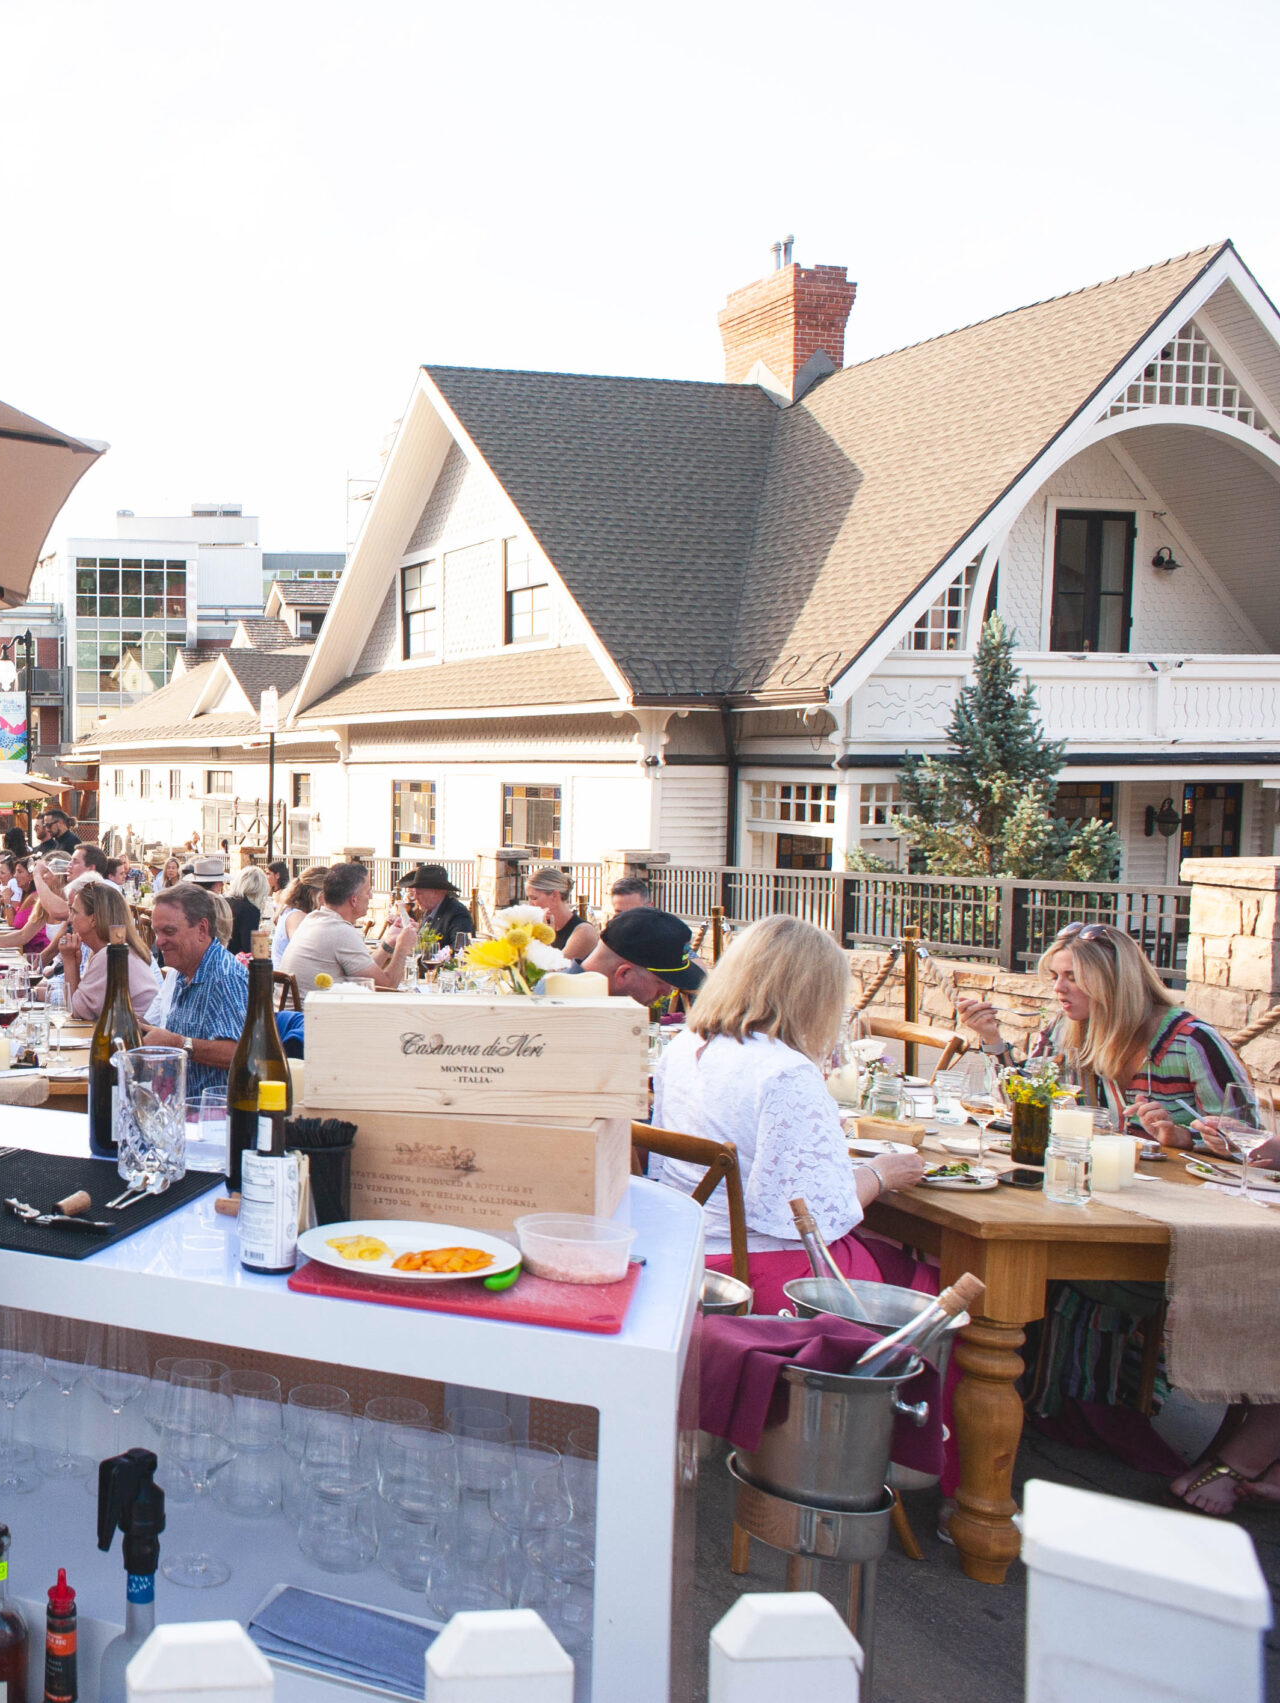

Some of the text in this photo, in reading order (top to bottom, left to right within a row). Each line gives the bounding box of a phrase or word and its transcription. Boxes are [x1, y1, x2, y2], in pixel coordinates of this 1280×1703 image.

[400, 1032, 547, 1058] Casanova di Neri
[440, 1065, 505, 1074] MONTALCINO
[479, 1196, 538, 1208] CALIFORNIA
